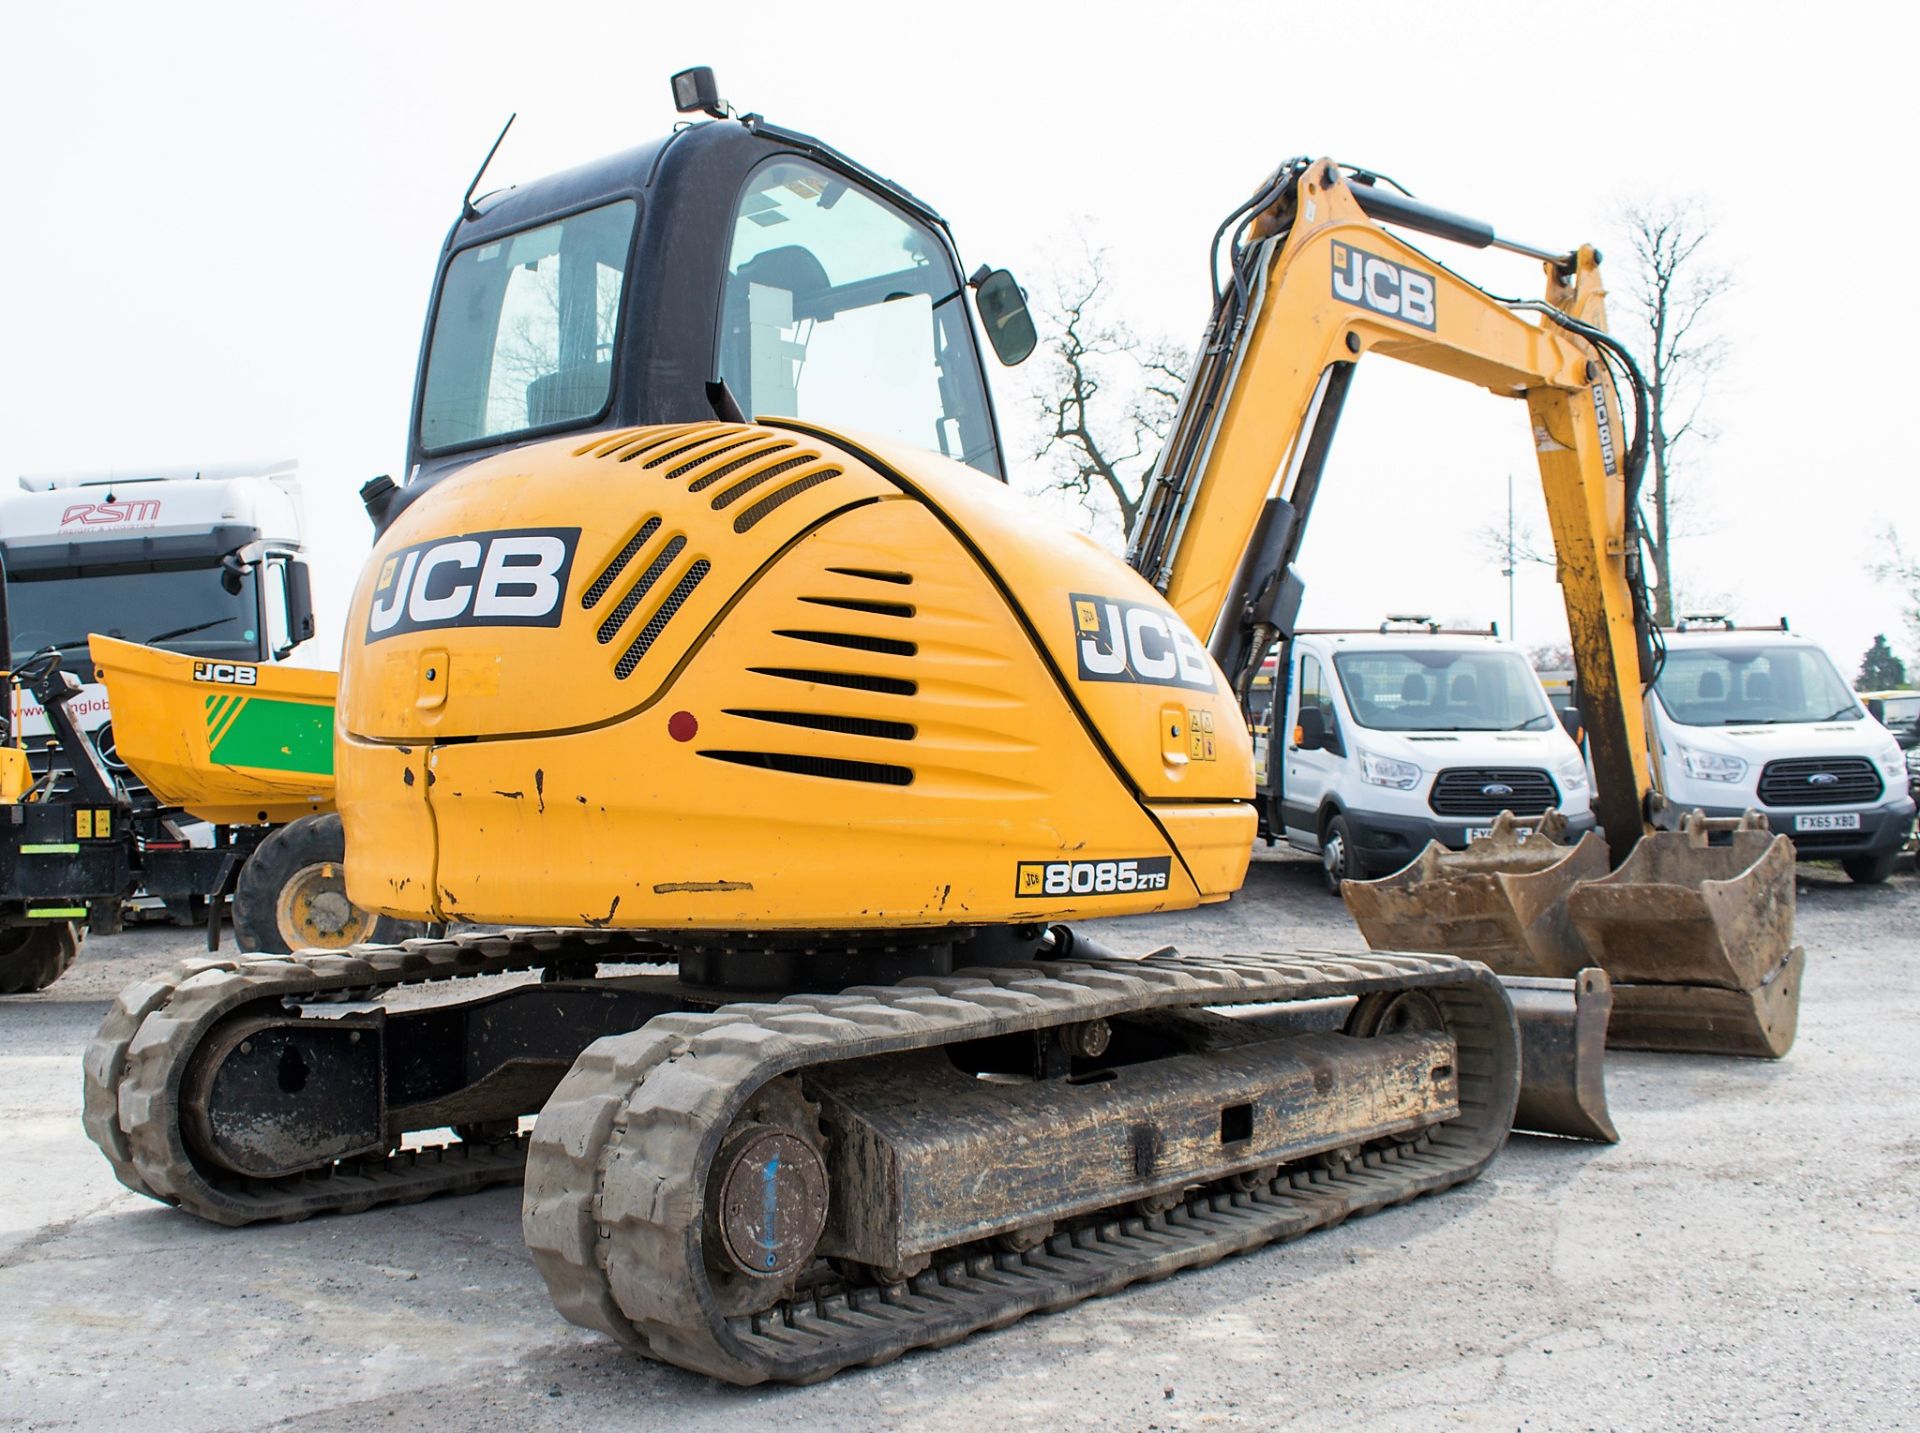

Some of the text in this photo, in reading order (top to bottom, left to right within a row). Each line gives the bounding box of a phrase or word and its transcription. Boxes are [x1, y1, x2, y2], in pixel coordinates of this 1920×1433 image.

[1333, 251, 1435, 325] JCB
[1593, 385, 1615, 465] 8085
[60, 500, 160, 526] RSM
[370, 536, 566, 633] JCB
[195, 664, 256, 684] JCB
[1081, 604, 1213, 686] JCB
[1045, 861, 1167, 894] 8085 ZTS
